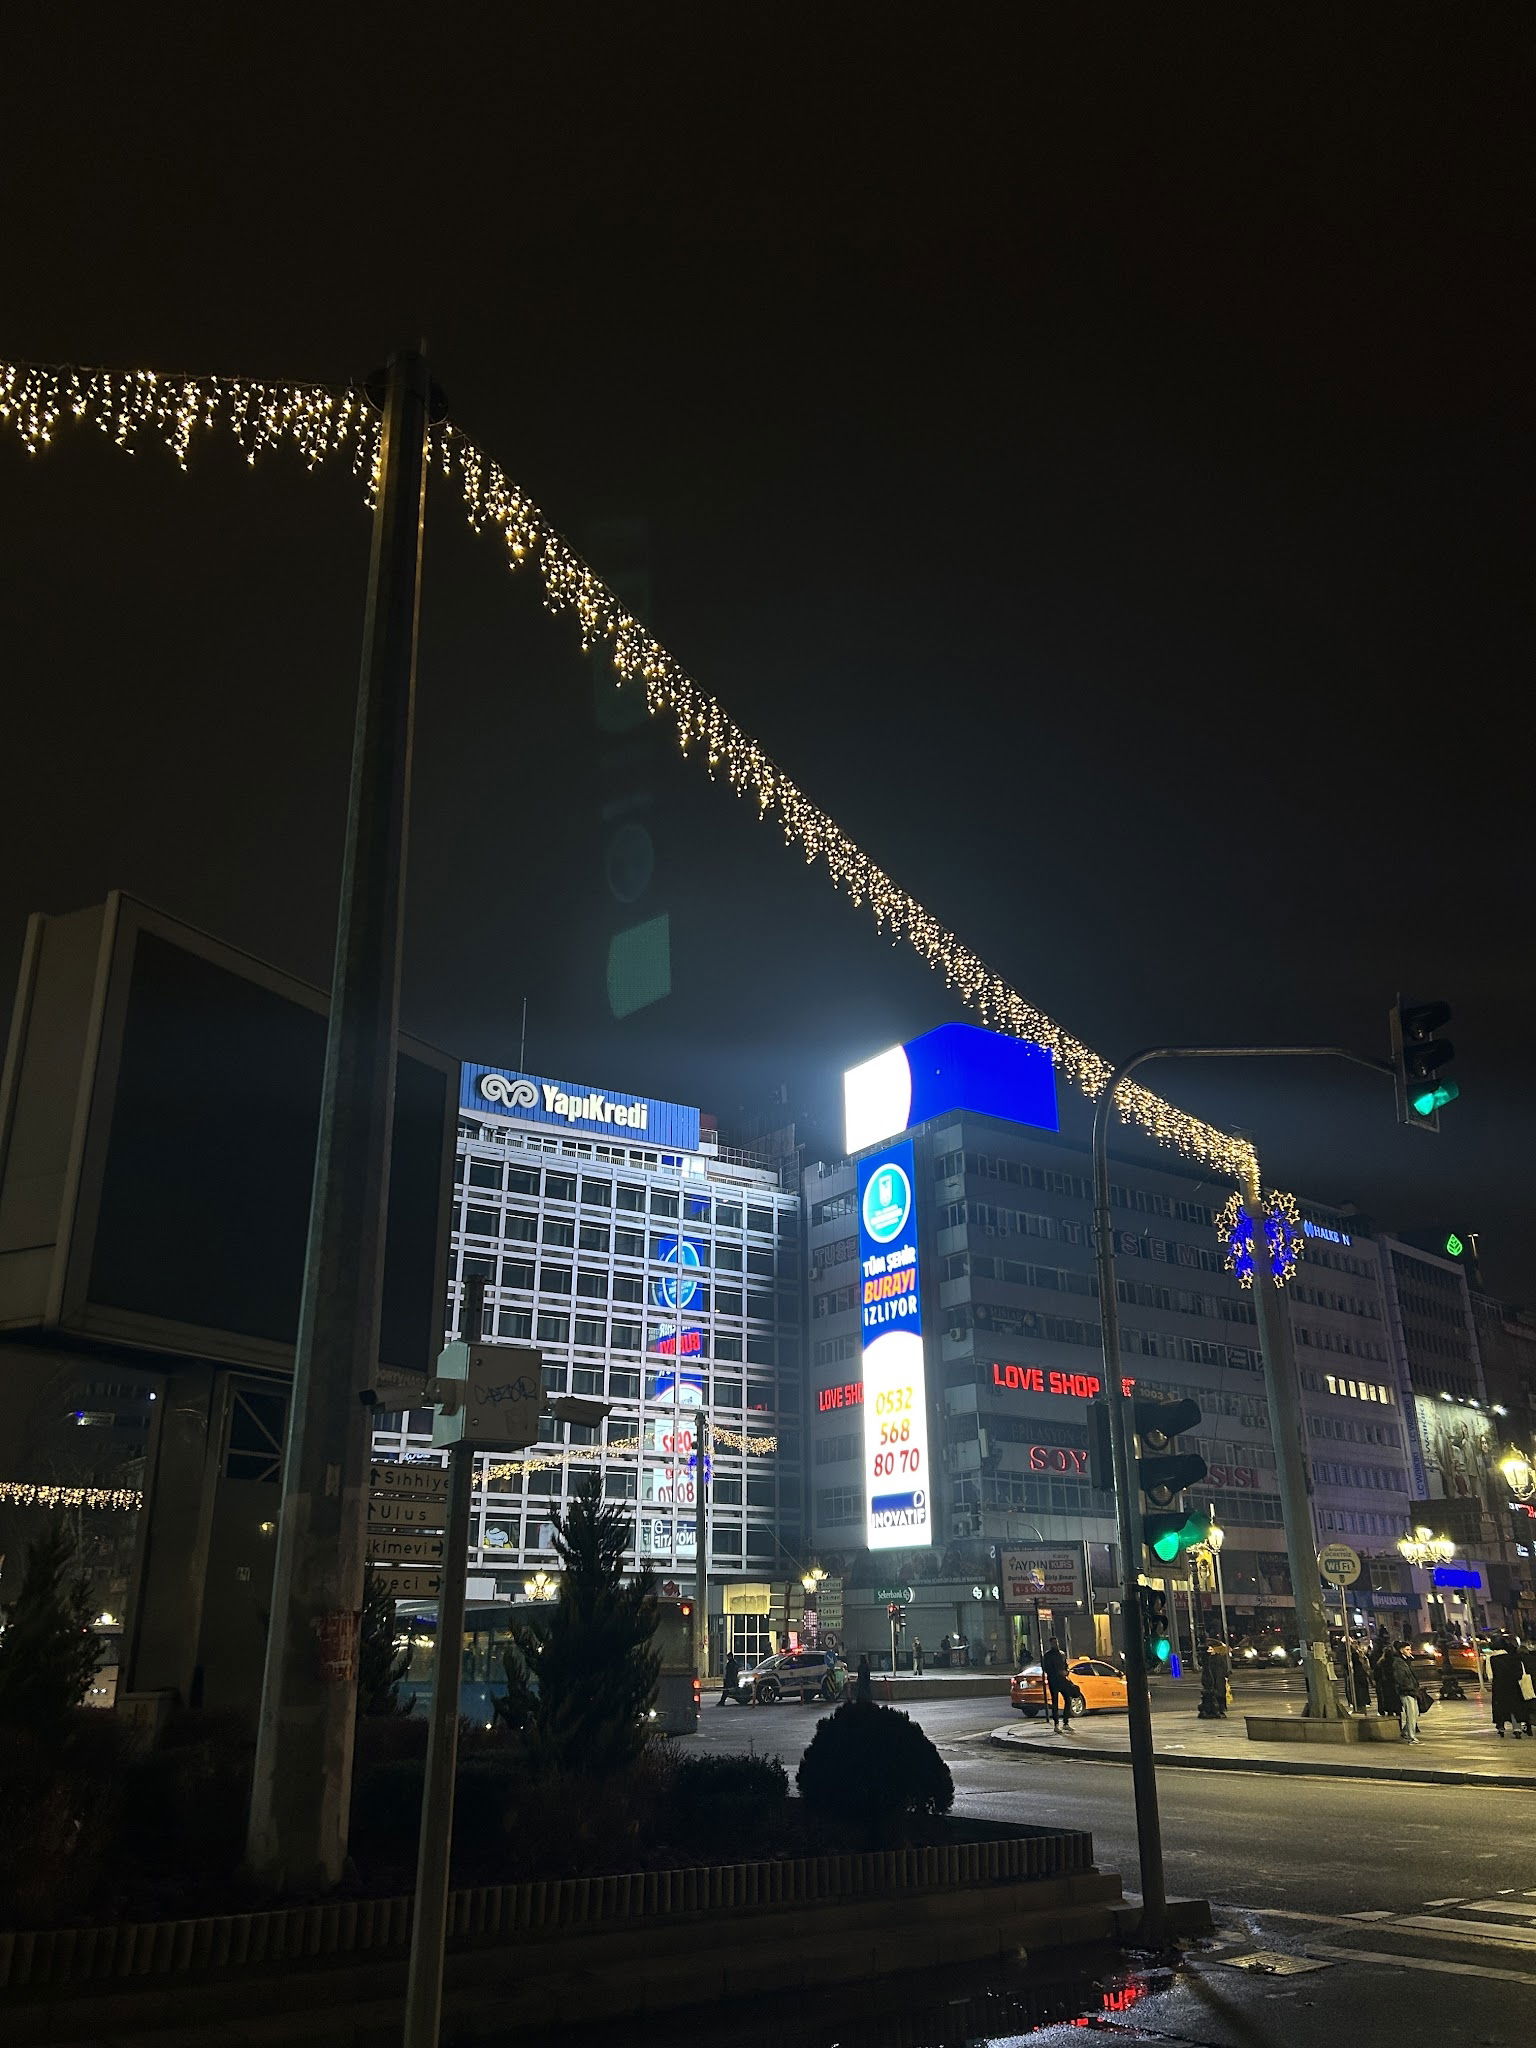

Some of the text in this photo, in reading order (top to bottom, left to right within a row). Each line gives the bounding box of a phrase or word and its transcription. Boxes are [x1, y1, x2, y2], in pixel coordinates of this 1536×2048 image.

[542, 1084, 648, 1129] YapıKredi
[863, 1244, 917, 1278] TÜM ŞEHİR
[864, 1268, 916, 1305] BURAYI
[993, 1363, 1045, 1393] LOVE
[1049, 1371, 1100, 1398] SHOP
[819, 1387, 843, 1411] LOVE
[875, 1386, 913, 1416] 0532
[880, 1418, 910, 1445] 568
[874, 1448, 920, 1477] 80 70
[381, 1505, 426, 1521] Ulus
